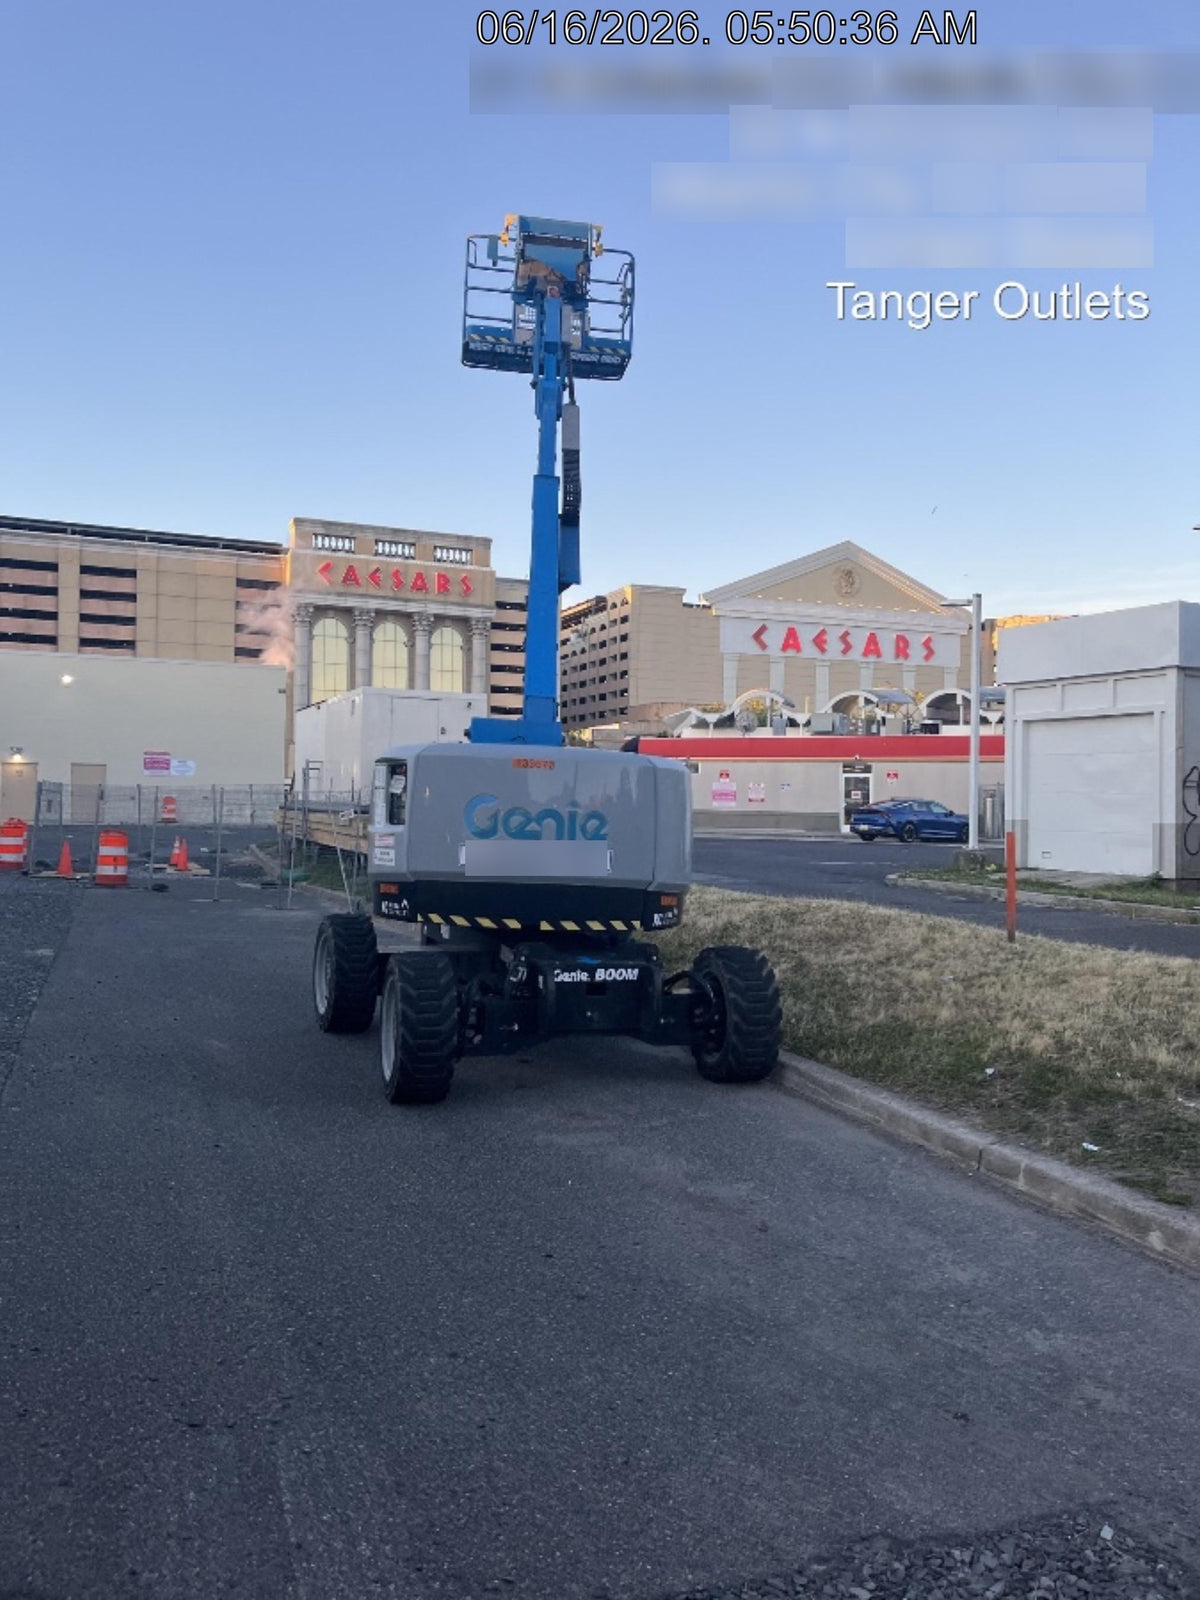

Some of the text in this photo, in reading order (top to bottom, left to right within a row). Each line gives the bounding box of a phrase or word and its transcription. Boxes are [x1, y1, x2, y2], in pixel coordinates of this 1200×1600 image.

[317, 561, 474, 596] CAESARS
[752, 623, 936, 662] CAESARS
[464, 793, 608, 840] Genie
[595, 968, 639, 981] BOOM
